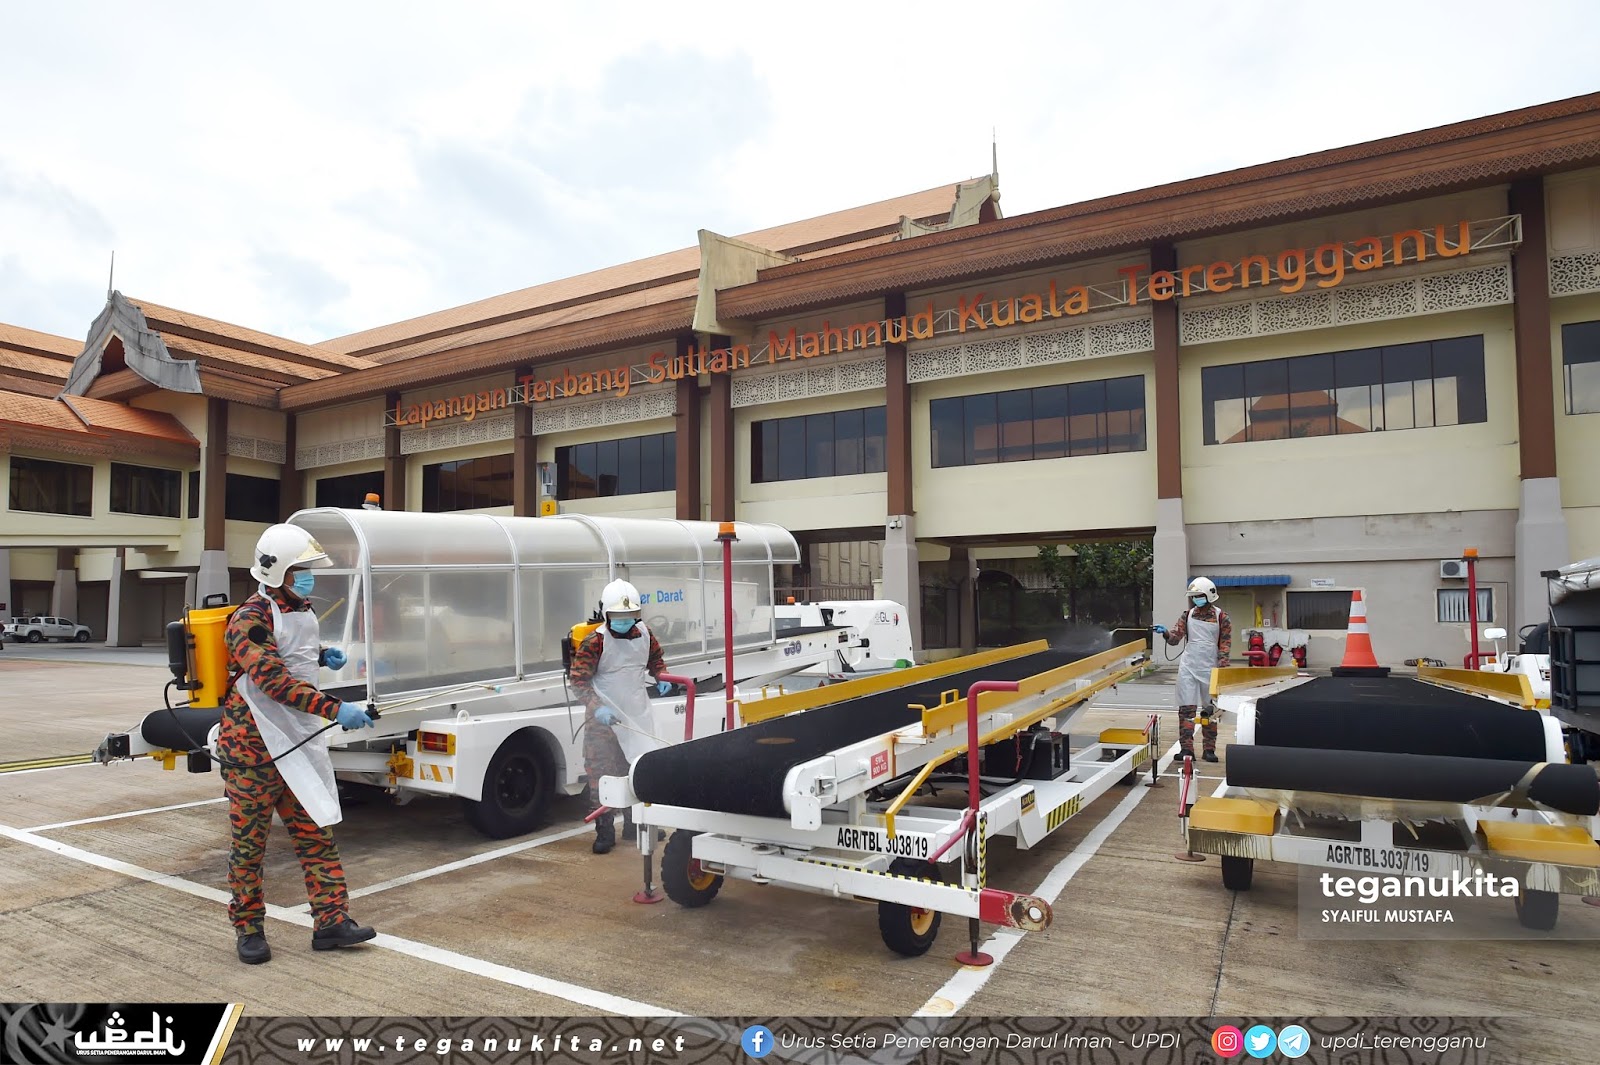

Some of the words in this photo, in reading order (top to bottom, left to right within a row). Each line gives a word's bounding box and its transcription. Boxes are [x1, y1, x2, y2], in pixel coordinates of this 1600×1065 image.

[395, 388, 507, 428] Lapangan
[518, 365, 631, 405] Terbang
[648, 344, 750, 383] Sultan
[768, 302, 934, 364] Mahmud
[958, 280, 1089, 333] Kuala
[1118, 220, 1471, 306] Terengganu
[545, 504, 551, 513] 3
[656, 589, 683, 603] Darat
[837, 827, 882, 853] AGR/TBL
[885, 835, 928, 858] 3038/19
[1326, 844, 1380, 868] AGR/TBL
[1380, 849, 1429, 872] 3037/19
